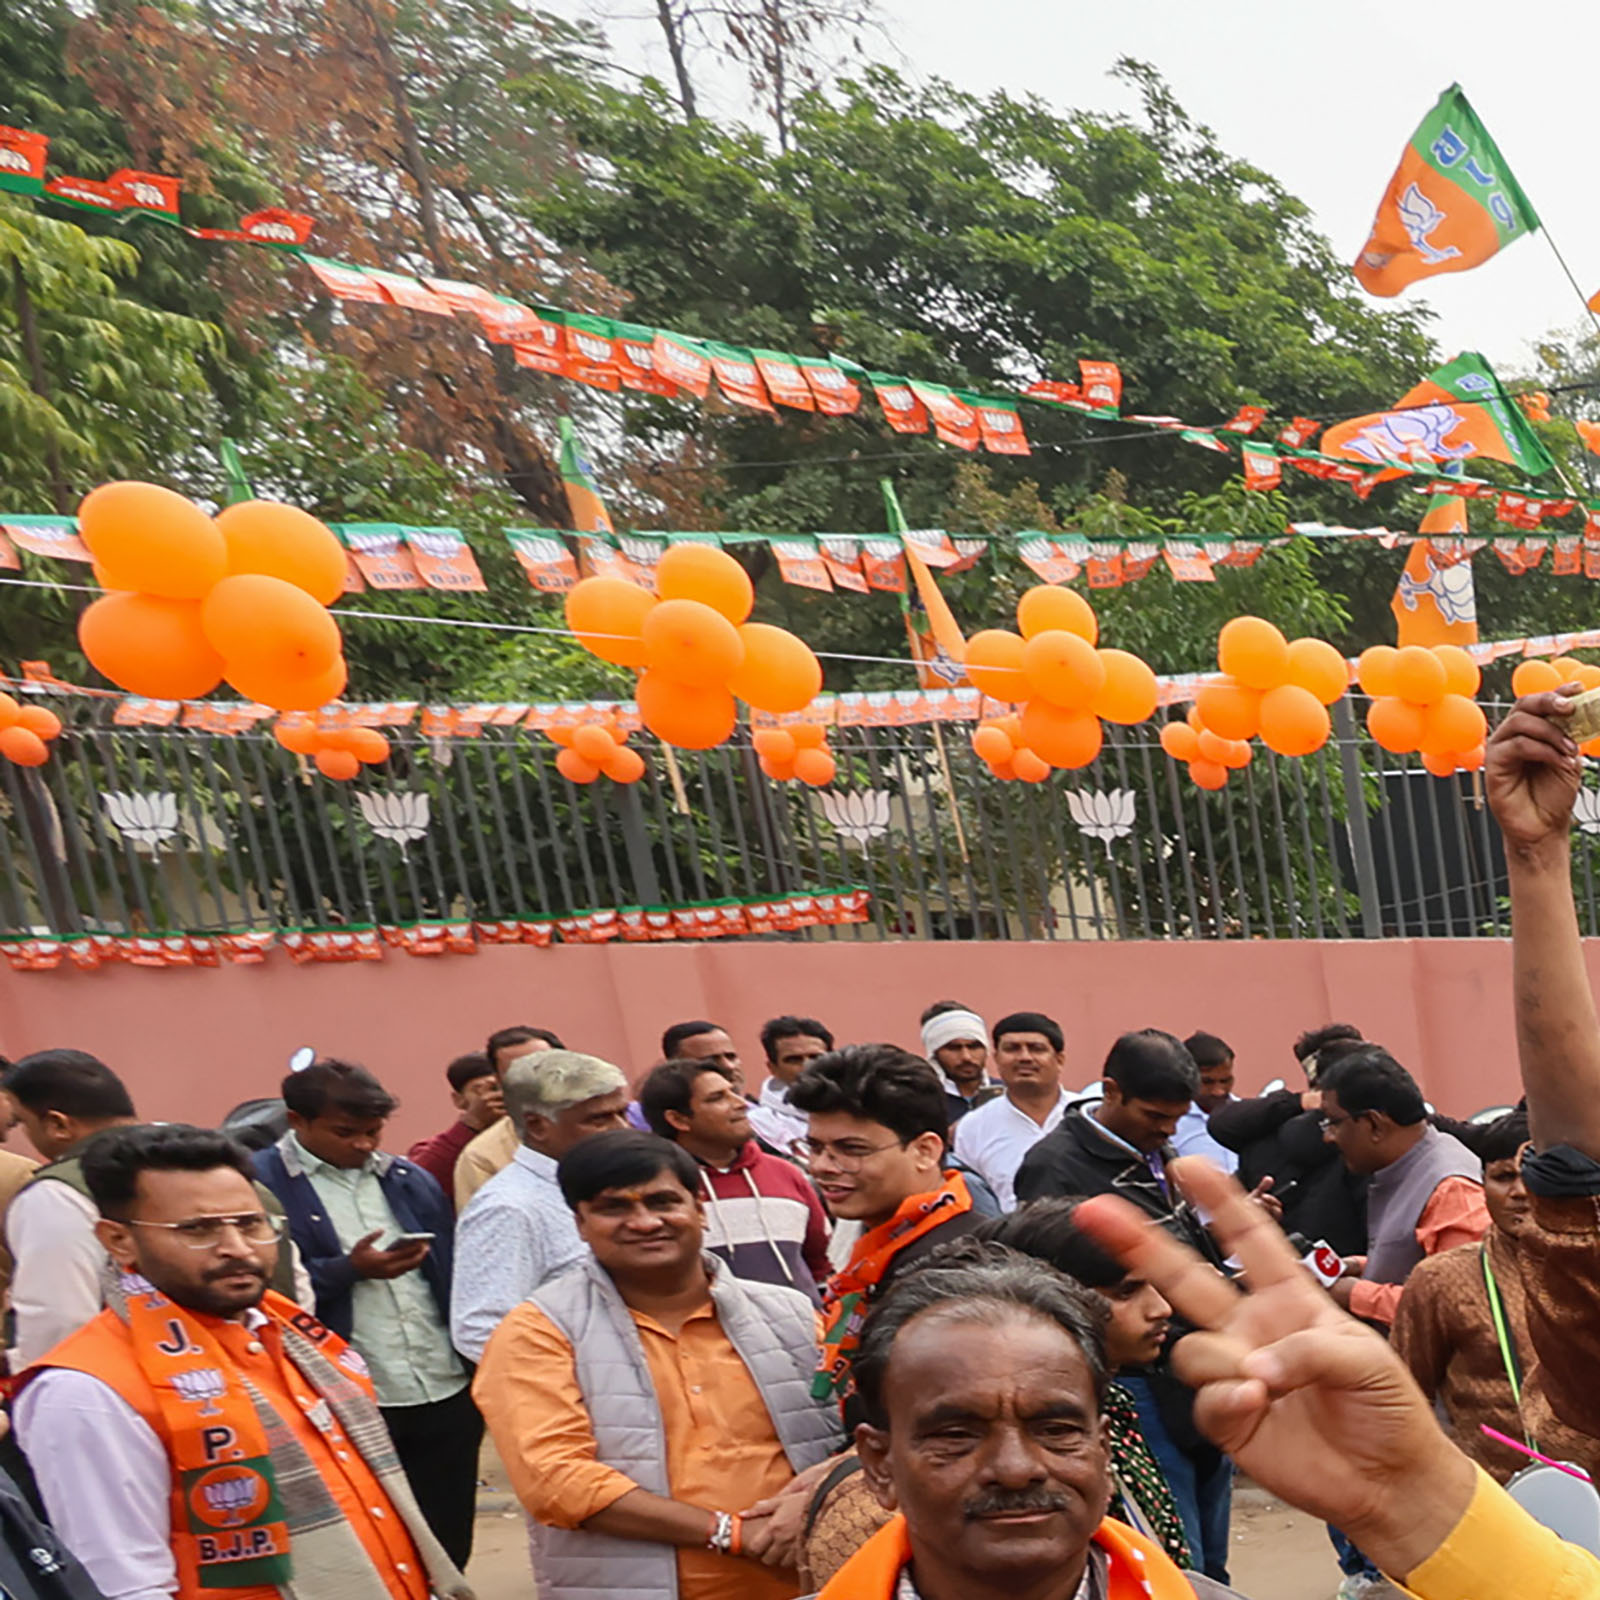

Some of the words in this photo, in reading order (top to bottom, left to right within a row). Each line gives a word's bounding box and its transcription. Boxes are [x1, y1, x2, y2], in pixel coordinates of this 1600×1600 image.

[157, 1317, 202, 1356] J.
[203, 1426, 242, 1461] P.
[200, 1530, 273, 1562] B.J.P.
